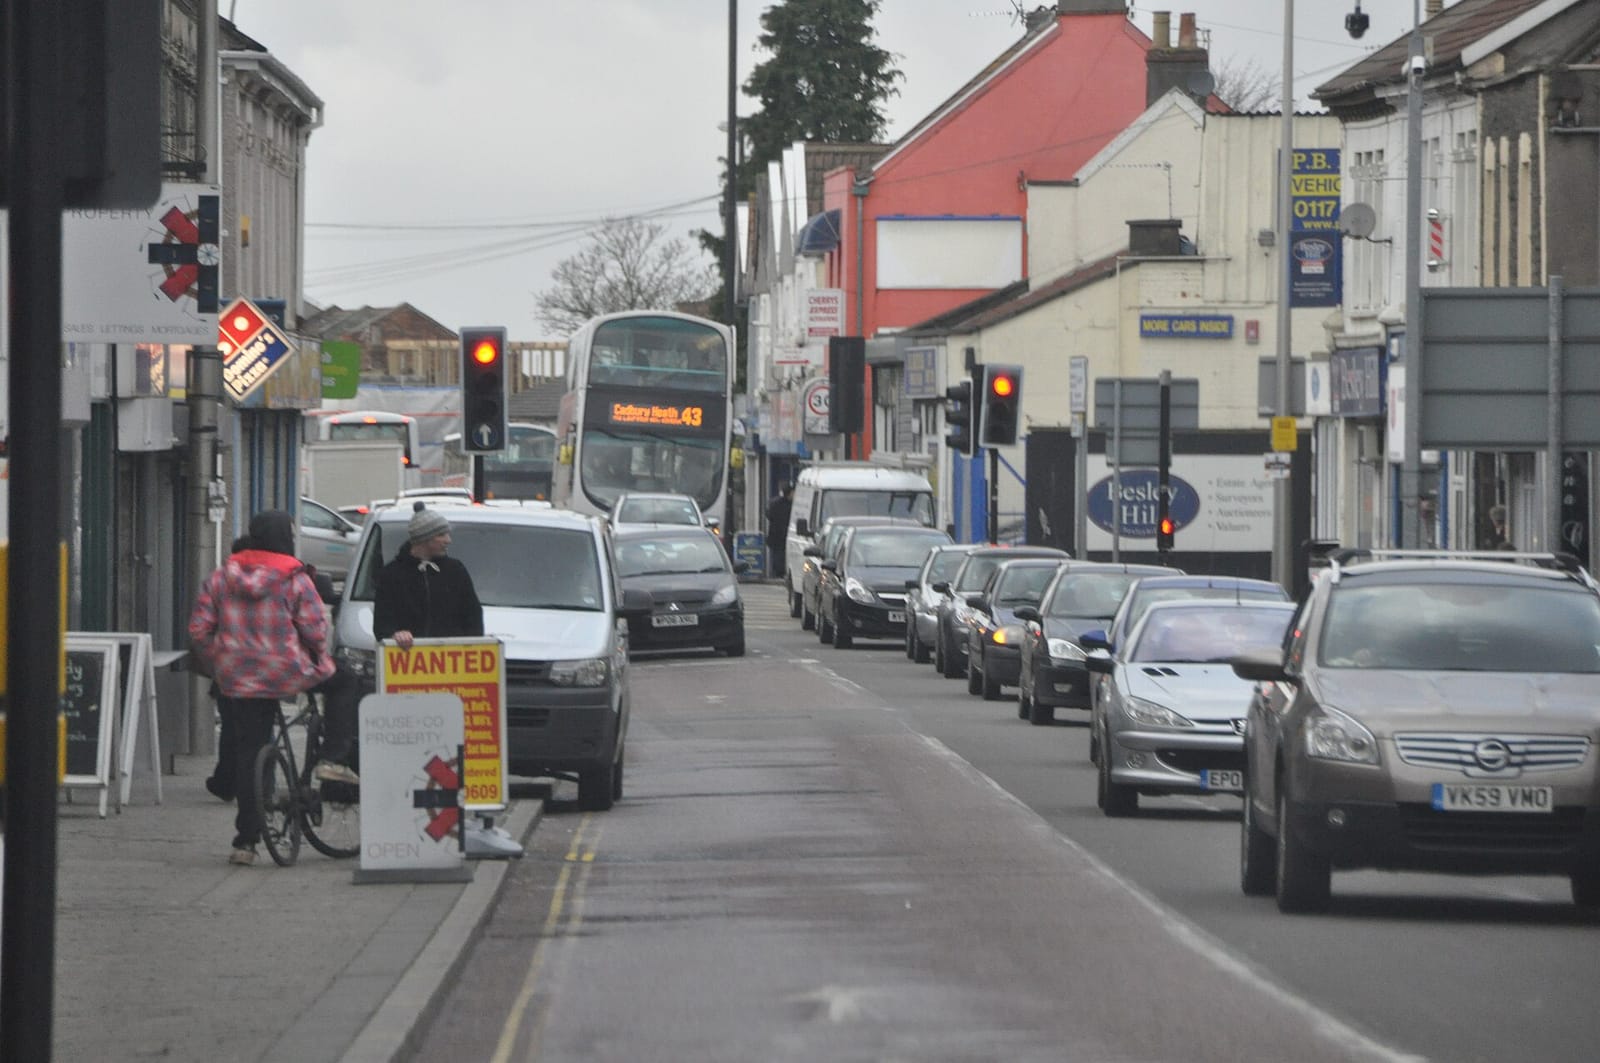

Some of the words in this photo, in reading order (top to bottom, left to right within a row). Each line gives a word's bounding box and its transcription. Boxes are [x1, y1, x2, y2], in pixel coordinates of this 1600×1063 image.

[71, 208, 154, 220] ROPERTY
[1294, 201, 1337, 218] 0117
[100, 324, 145, 334] LETTINGS
[151, 325, 209, 335] MORTGAGES
[1171, 320, 1197, 332] CARS
[681, 407, 703, 426] 43
[388, 651, 496, 675] WANTED
[365, 732, 442, 744] PROPERTY
[1446, 787, 1501, 806] VK59
[368, 843, 420, 859] OPEN
